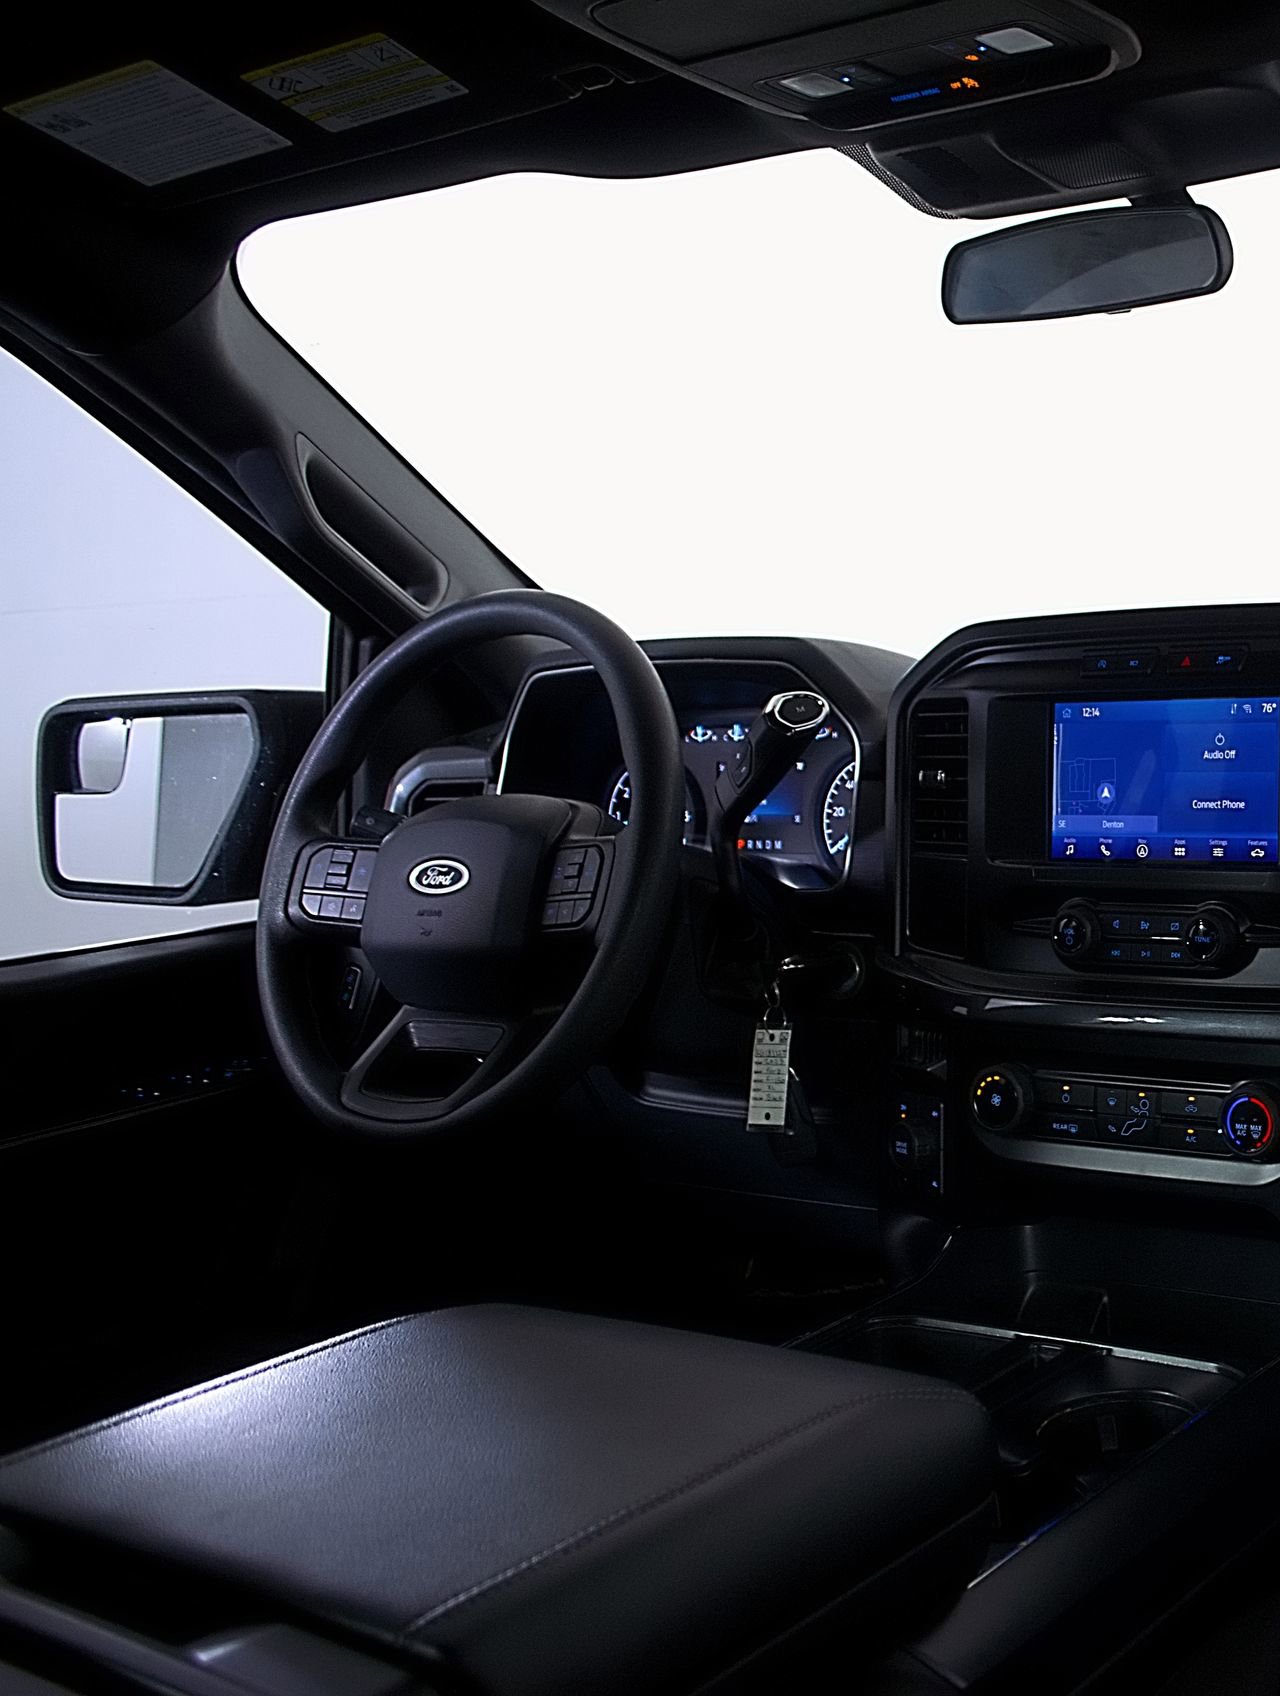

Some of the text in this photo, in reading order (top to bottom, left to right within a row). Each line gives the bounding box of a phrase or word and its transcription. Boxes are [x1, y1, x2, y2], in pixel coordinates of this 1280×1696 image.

[1082, 708, 1100, 717] 12:14
[1203, 750, 1236, 759] Audio Off
[623, 787, 630, 798] 2
[1192, 800, 1245, 809] Connect Phone
[832, 807, 845, 816] 20
[1058, 820, 1066, 828] SE
[1102, 820, 1124, 828] Denton
[738, 839, 782, 849] P R N D M
[421, 865, 455, 886] Ford
[1052, 1122, 1068, 1131] REAR
[1185, 1134, 1197, 1143] A/C
